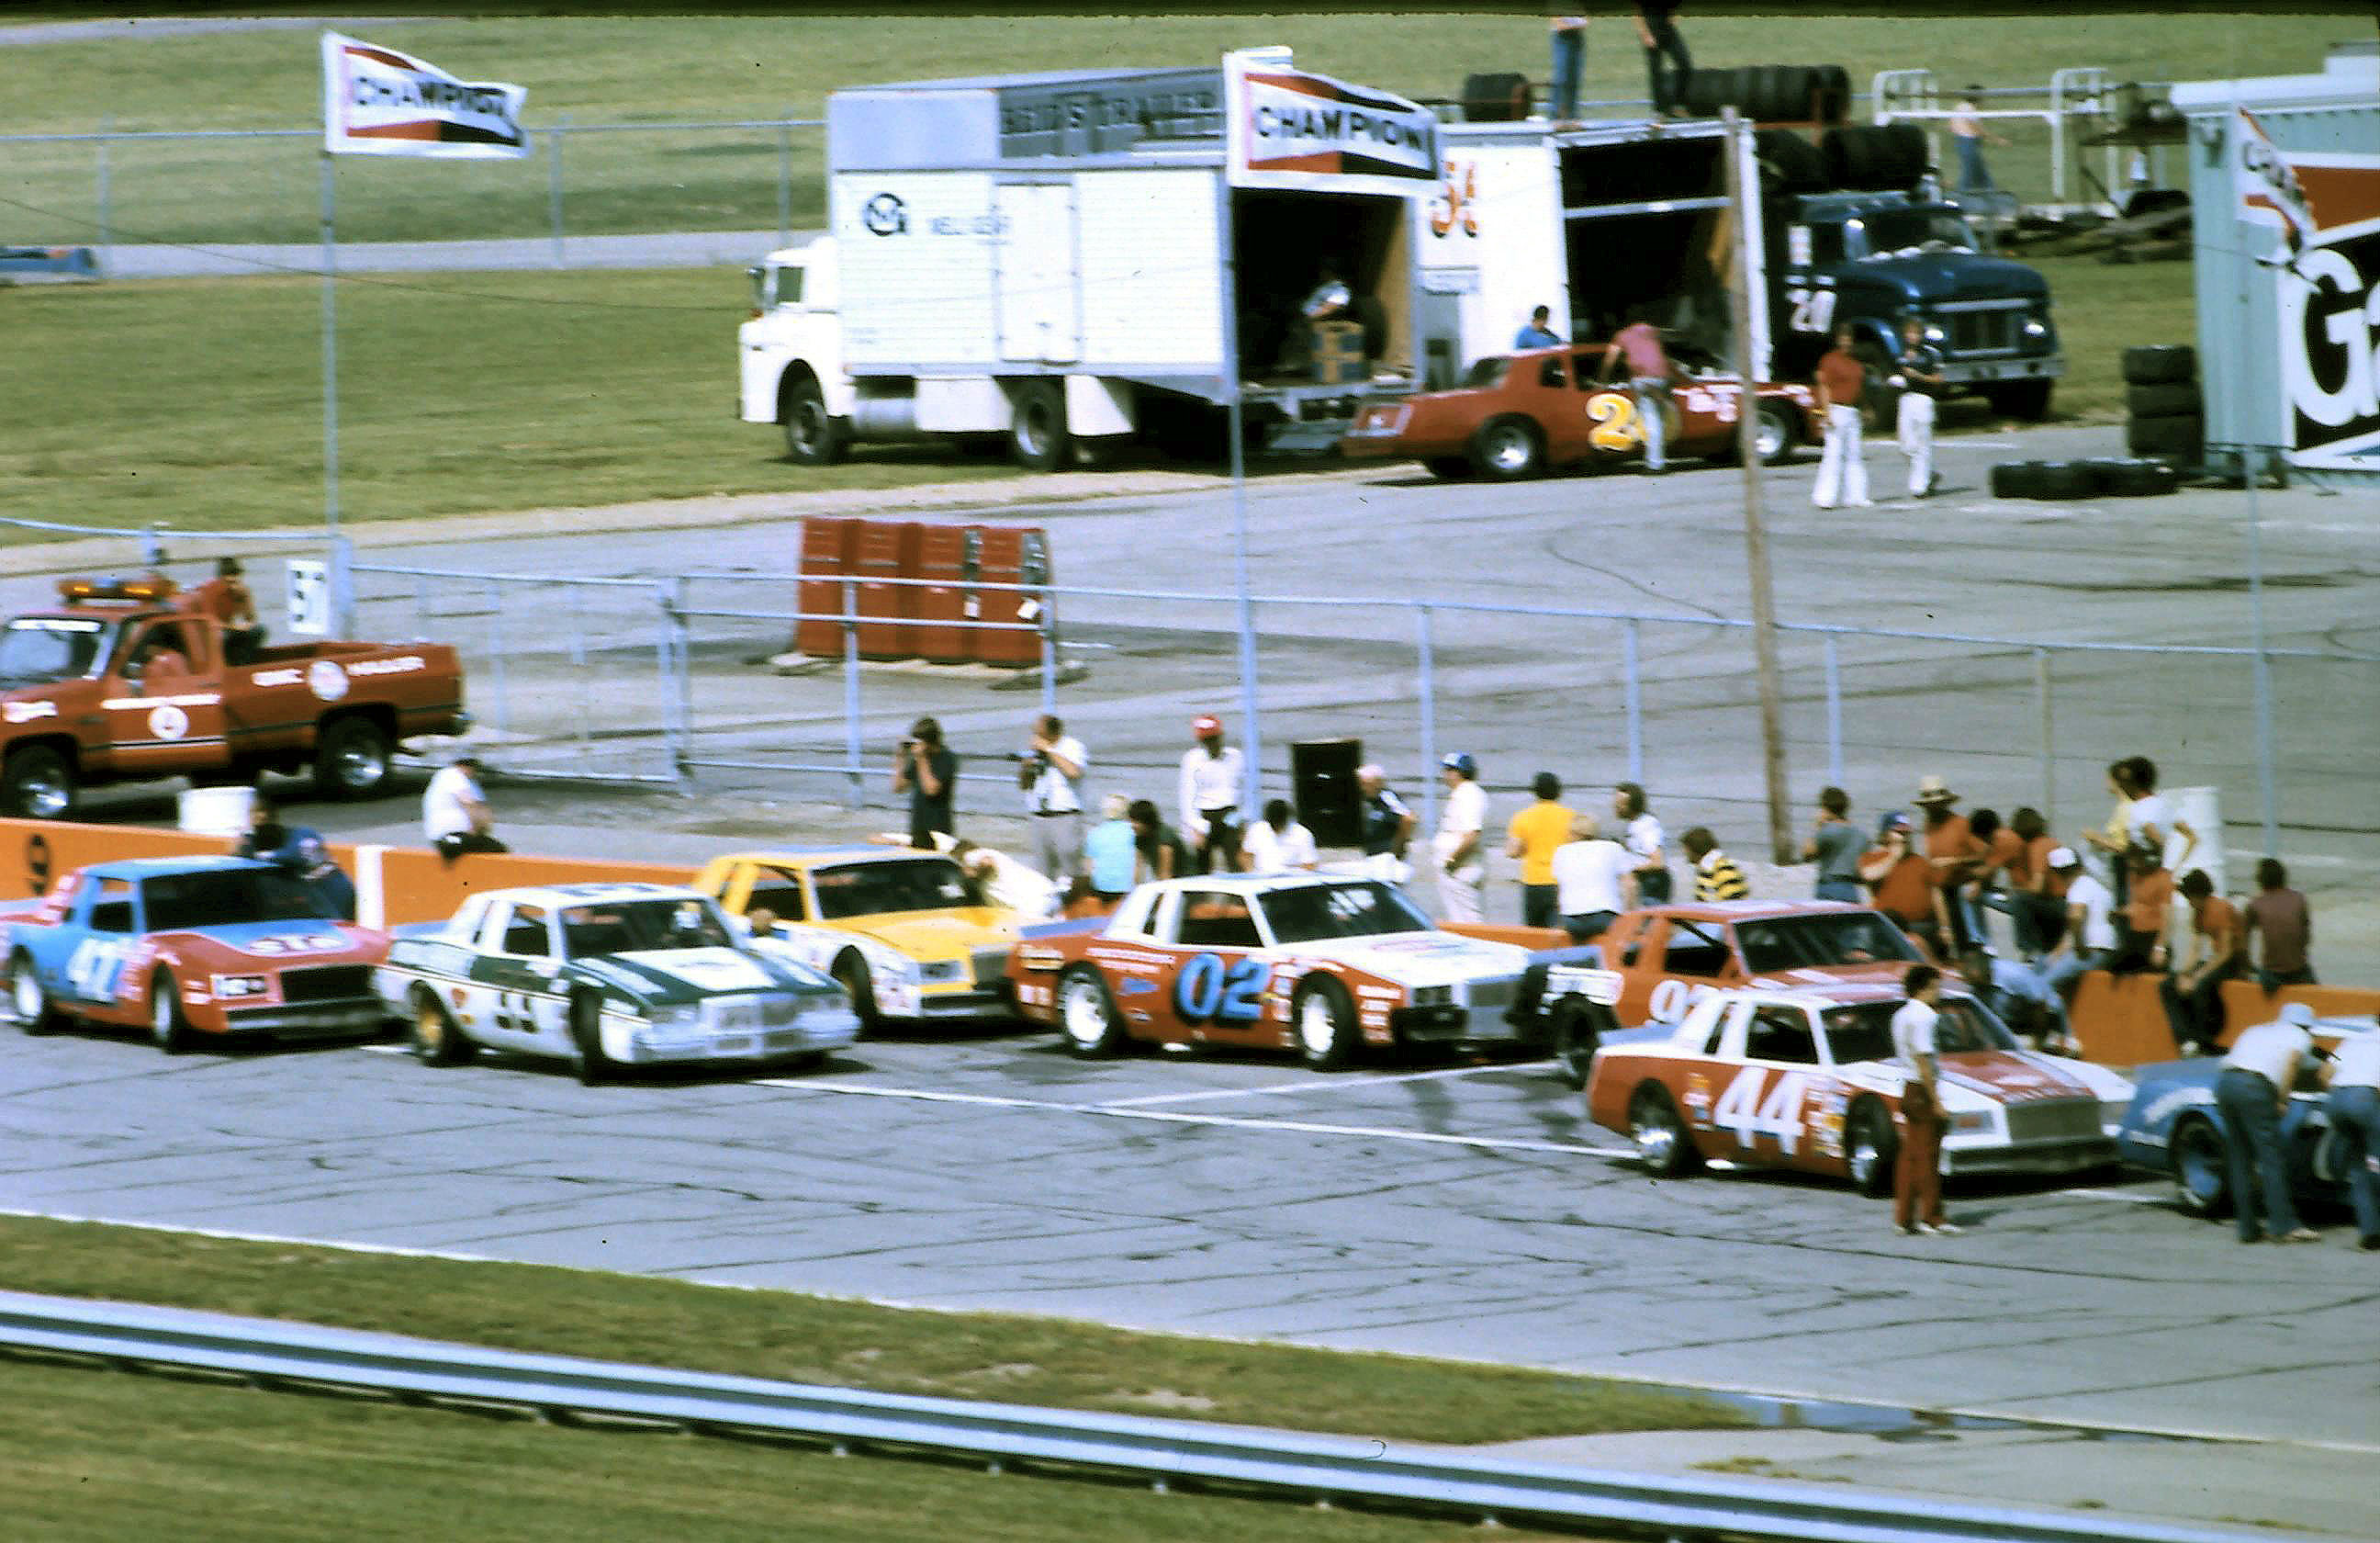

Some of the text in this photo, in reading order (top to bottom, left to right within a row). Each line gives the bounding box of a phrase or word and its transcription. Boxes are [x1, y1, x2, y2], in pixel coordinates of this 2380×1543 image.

[1255, 106, 1426, 151] CHAMPION
[1175, 952, 1271, 1026] 02
[1712, 1067, 1808, 1154] 44
